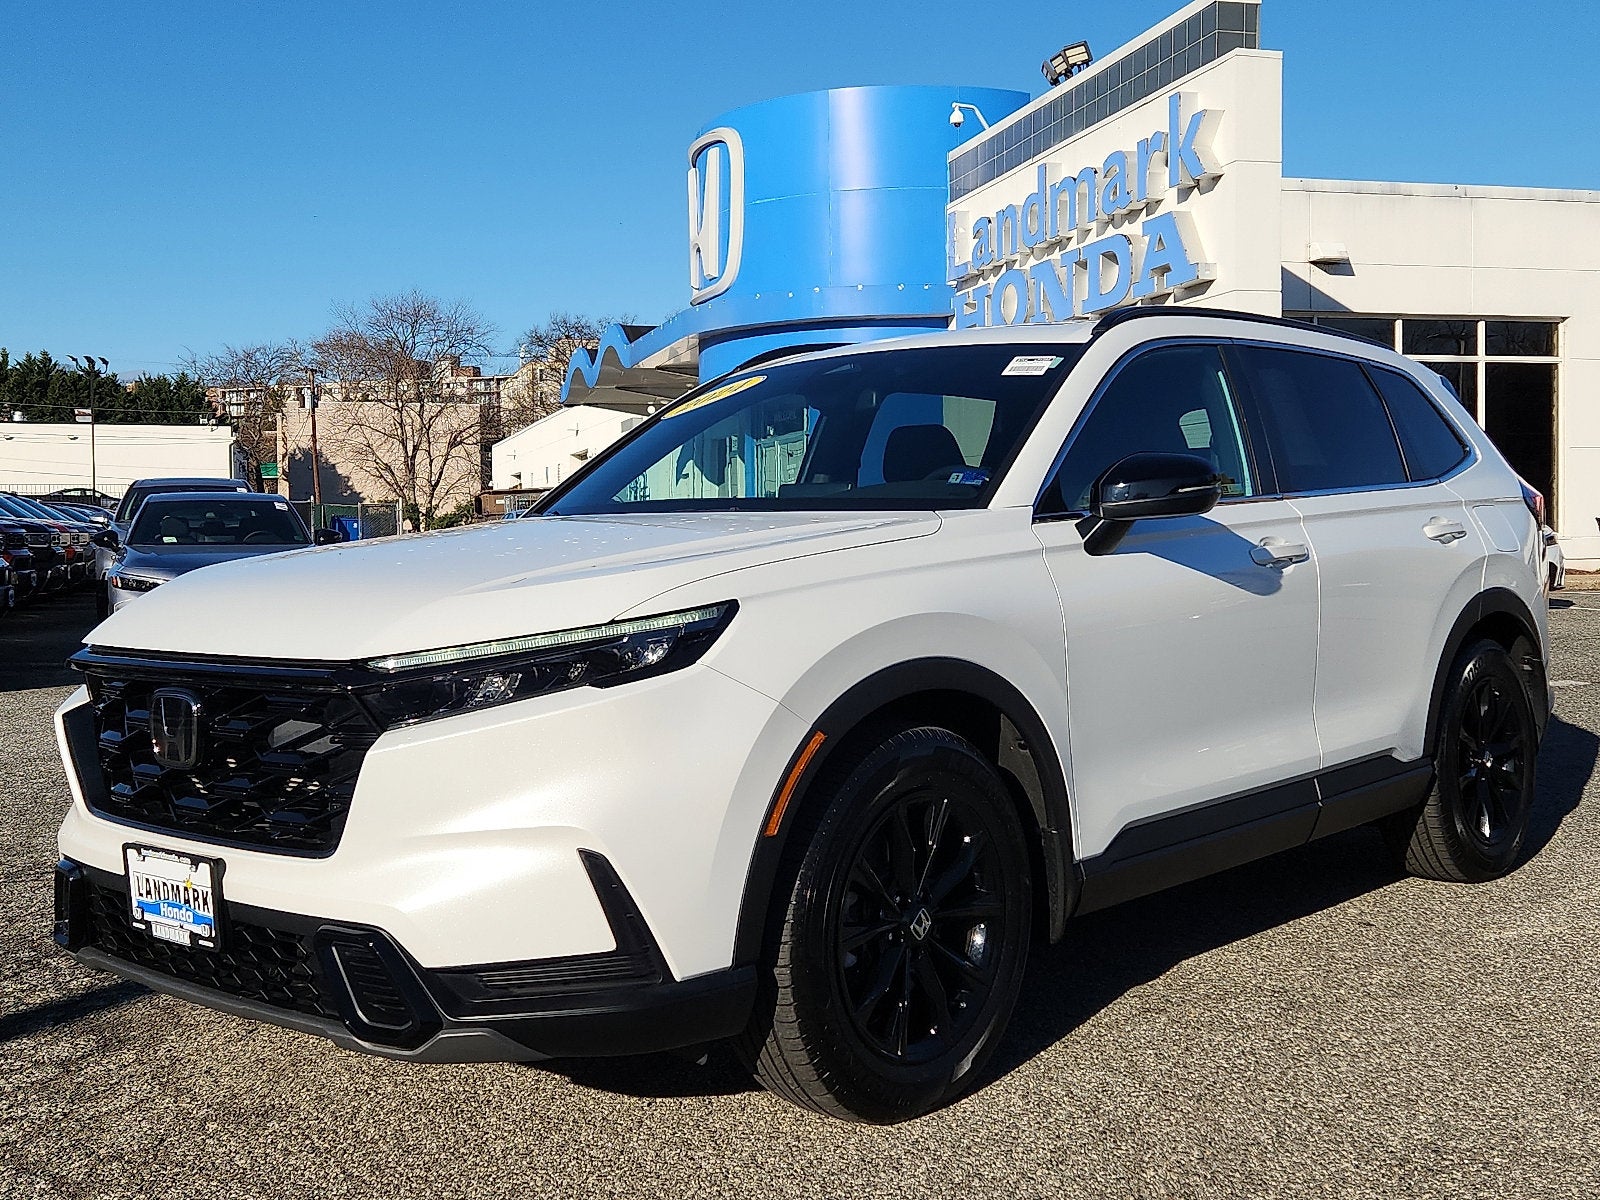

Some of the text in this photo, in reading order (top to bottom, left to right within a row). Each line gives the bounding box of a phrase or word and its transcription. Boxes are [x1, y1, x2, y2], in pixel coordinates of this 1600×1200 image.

[948, 92, 1211, 283] Landmark
[953, 211, 1201, 330] HONDA
[134, 874, 211, 914] LANDMARK
[160, 902, 194, 923] Honda
